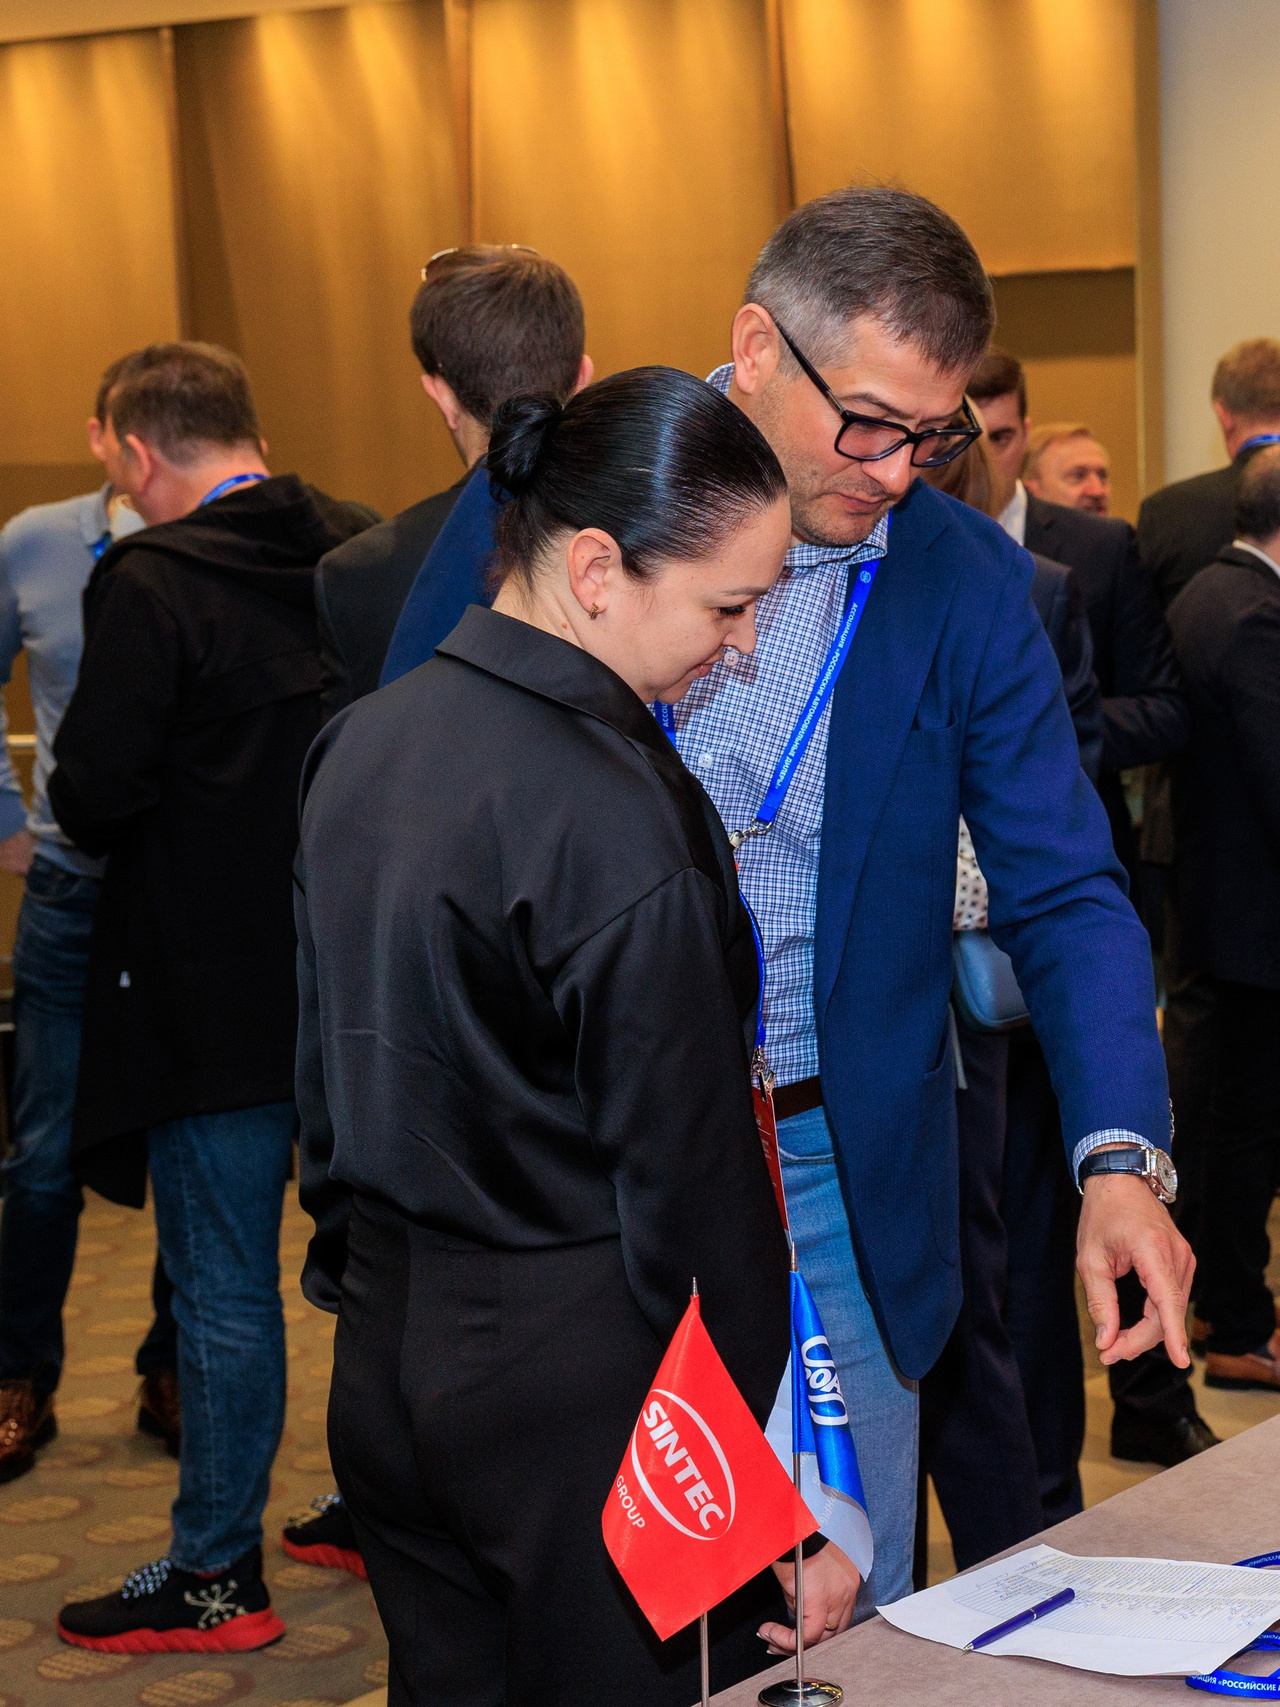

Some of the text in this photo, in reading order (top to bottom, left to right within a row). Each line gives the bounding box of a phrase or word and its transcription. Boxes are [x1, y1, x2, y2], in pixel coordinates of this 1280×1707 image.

[789, 697, 821, 757] АВТОМОБИЛЬНЫЕ
[643, 1401, 725, 1530] SINTEC
[617, 1475, 645, 1528] GROUP
[1218, 1680, 1276, 1691] «РОССИЙСКИЕ
